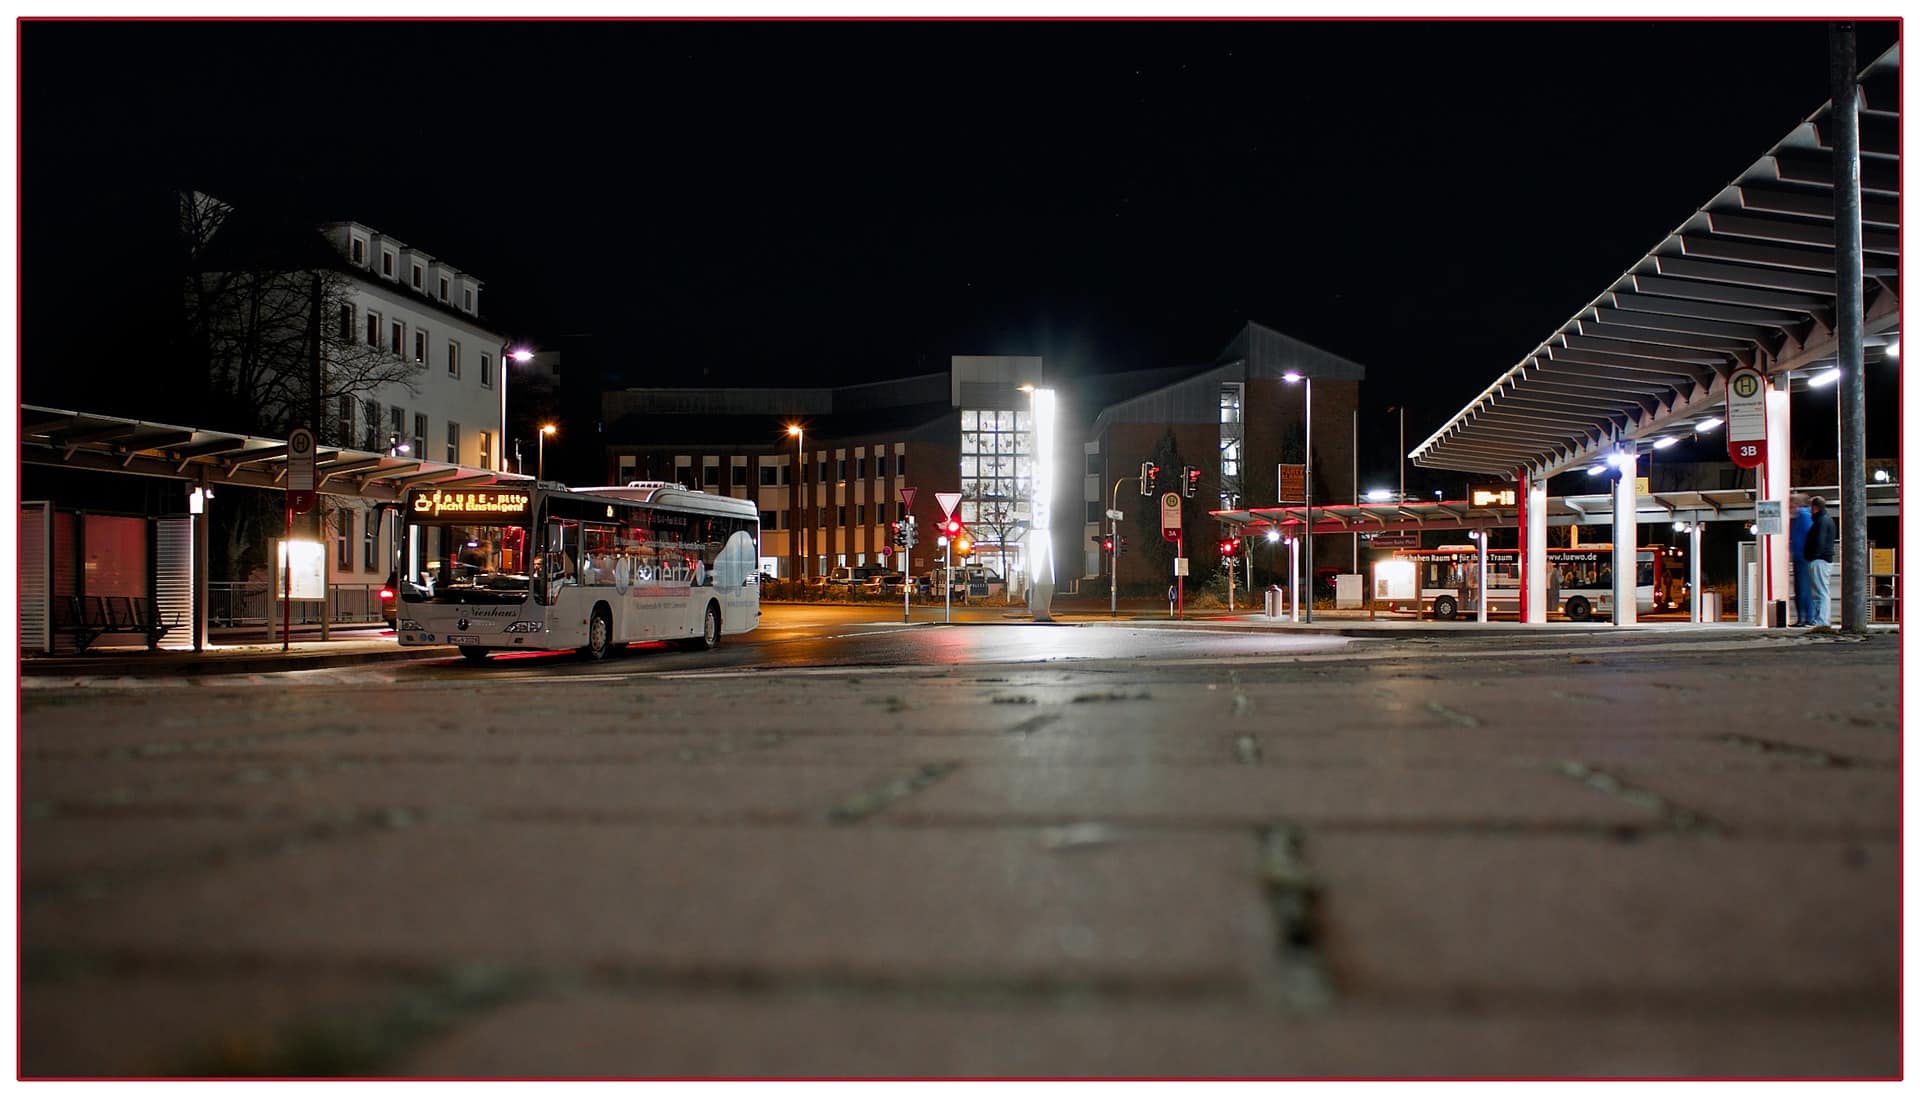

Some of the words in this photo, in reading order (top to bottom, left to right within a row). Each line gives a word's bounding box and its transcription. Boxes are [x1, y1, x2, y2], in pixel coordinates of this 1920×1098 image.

[1740, 446, 1757, 456] 3B
[296, 496, 303, 504] F
[497, 494, 528, 504] Bitte
[436, 502, 463, 511] nicht
[465, 502, 524, 512] Einsteigen!
[1409, 554, 1430, 562] haben
[1431, 554, 1450, 562] Raum
[1459, 553, 1470, 563] für
